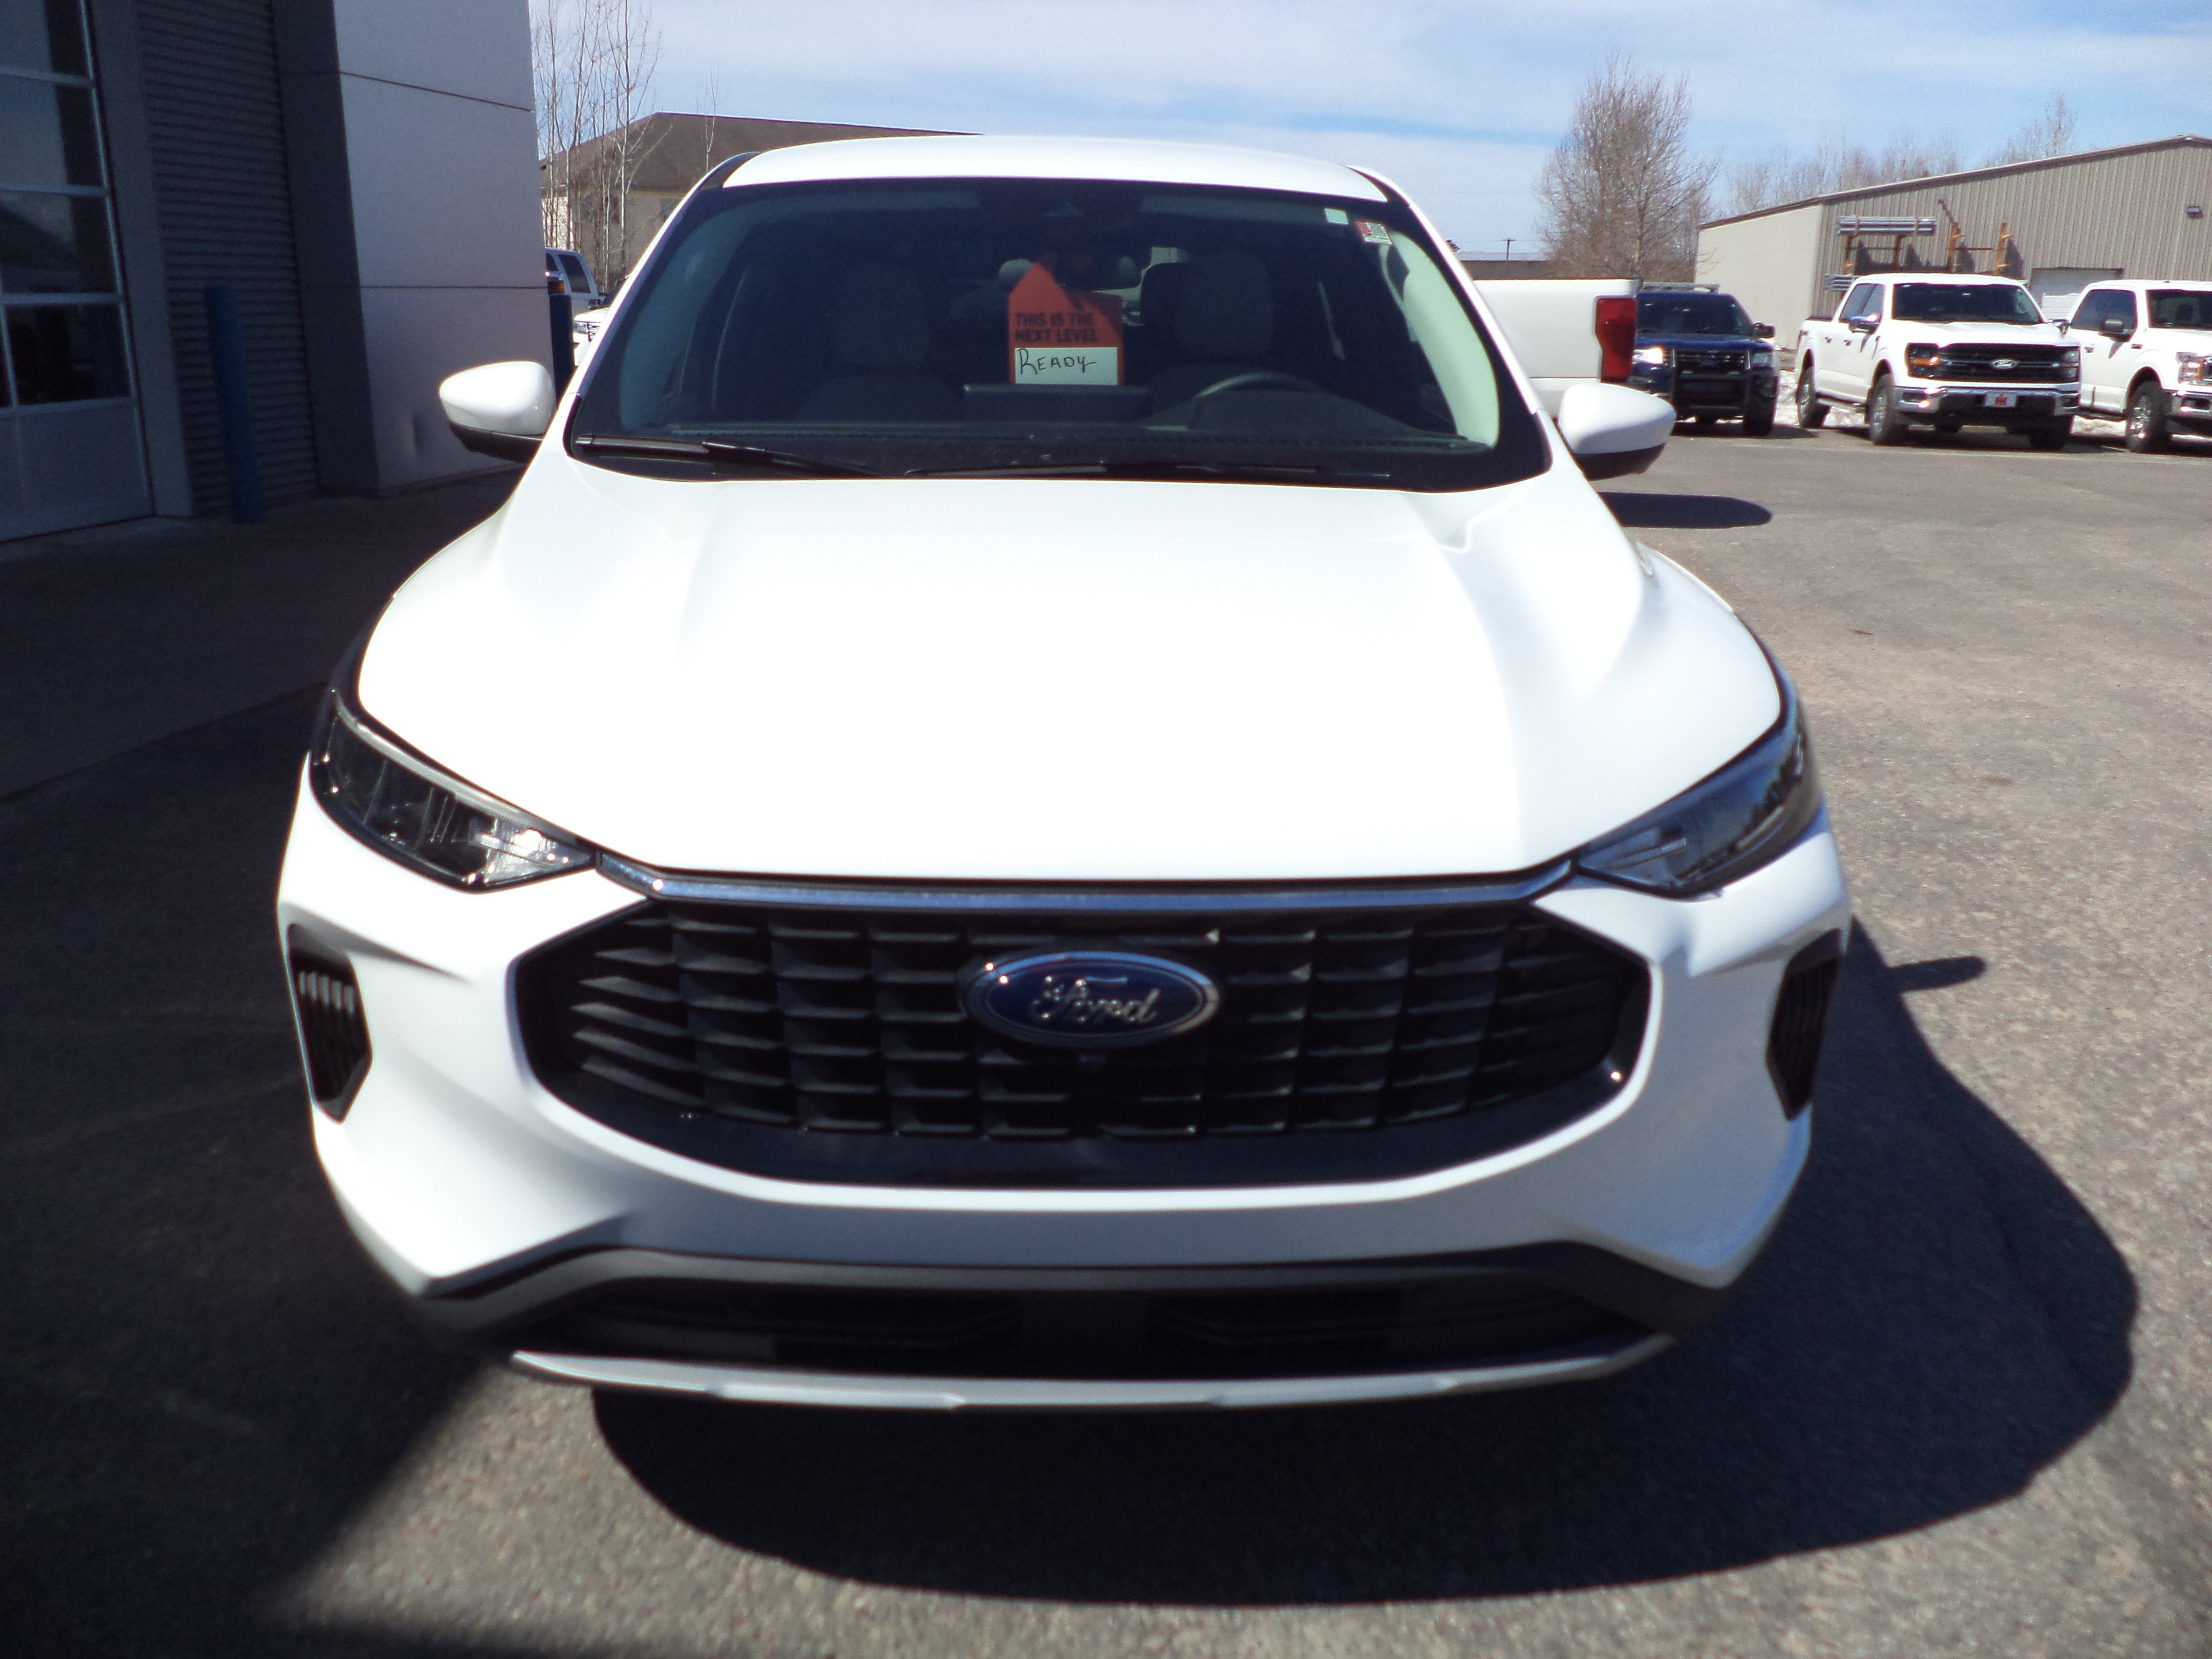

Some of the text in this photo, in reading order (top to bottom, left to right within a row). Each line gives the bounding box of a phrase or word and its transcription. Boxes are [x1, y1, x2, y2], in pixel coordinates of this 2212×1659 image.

[1016, 312, 1095, 326] THIS IS THE
[1016, 328, 1099, 343] NEXT LEVEL
[1029, 974, 1161, 1024] Ford
